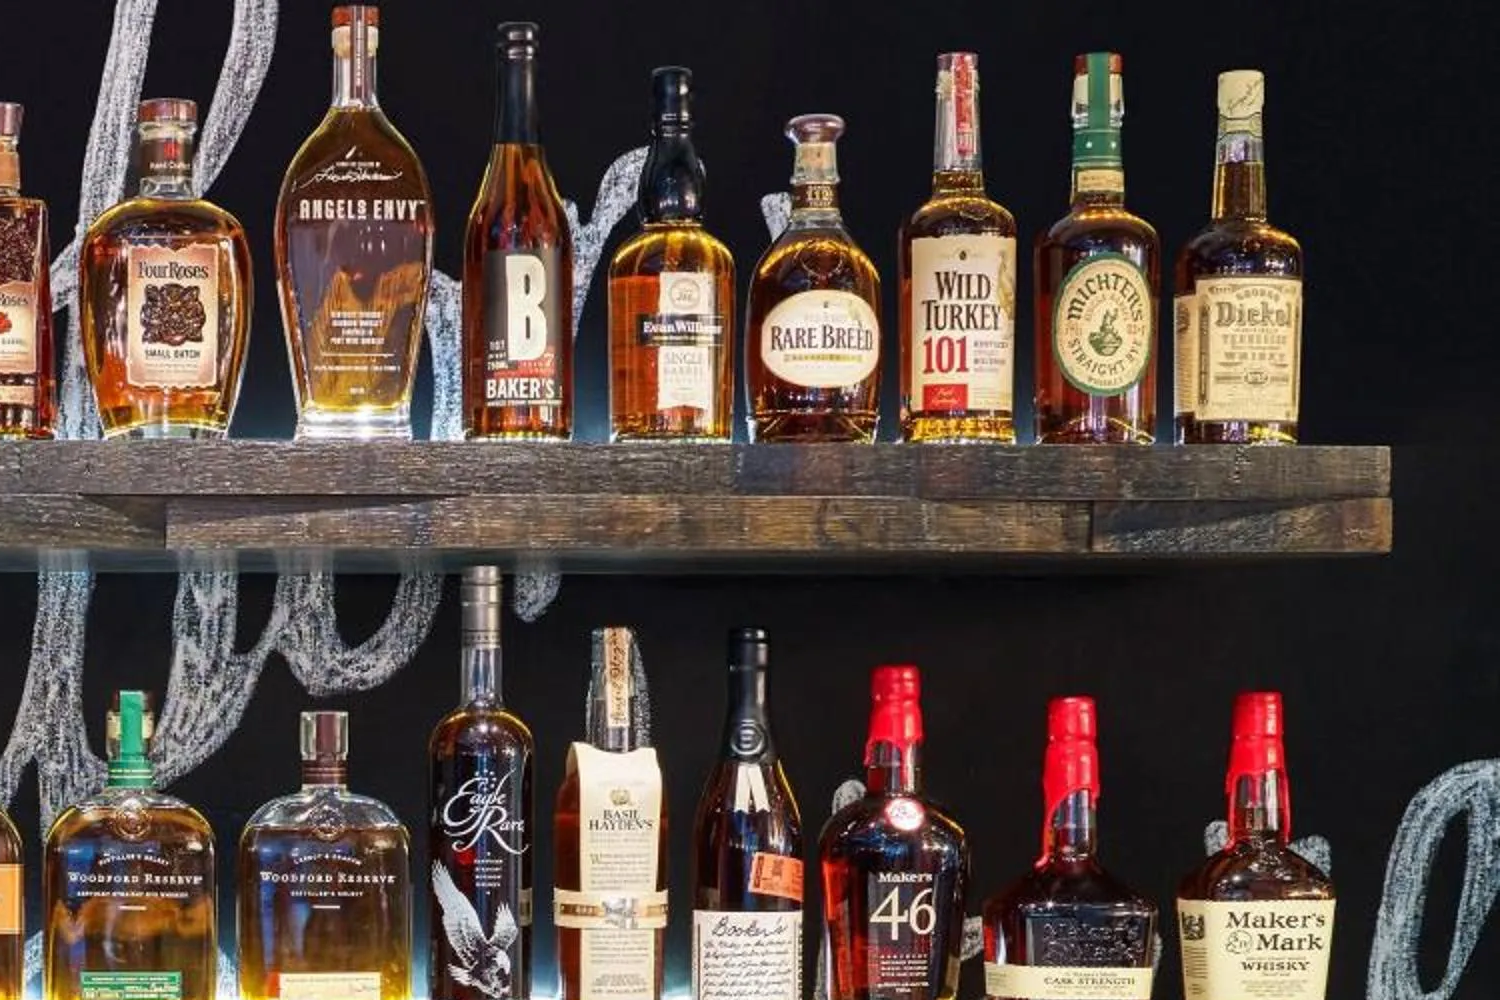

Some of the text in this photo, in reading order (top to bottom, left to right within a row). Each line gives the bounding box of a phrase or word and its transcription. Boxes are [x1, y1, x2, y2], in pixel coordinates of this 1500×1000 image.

[137, 261, 209, 279] Four Roses
[934, 269, 992, 302] WILD
[1066, 273, 1143, 322] MICHTER'S
[505, 255, 547, 361] B
[921, 299, 1001, 332] TURKEY
[643, 321, 675, 334] Evan
[771, 323, 874, 351] RARE BREED
[922, 335, 970, 375] 101
[1067, 337, 1126, 376] STRAIGHT
[485, 378, 556, 399] BAKER'S
[443, 767, 516, 837] Eagle
[603, 809, 640, 820] BASIL
[451, 805, 531, 855] Rare
[67, 871, 204, 885] WOODFORD RESERVE
[259, 870, 397, 883] WOODFORD RESERVE
[869, 886, 937, 941] 46
[1226, 911, 1326, 929] Maker's
[1256, 933, 1325, 951] Mark
[1240, 961, 1311, 971] WHISKY
[1044, 977, 1136, 986] CASK STRENGTH
